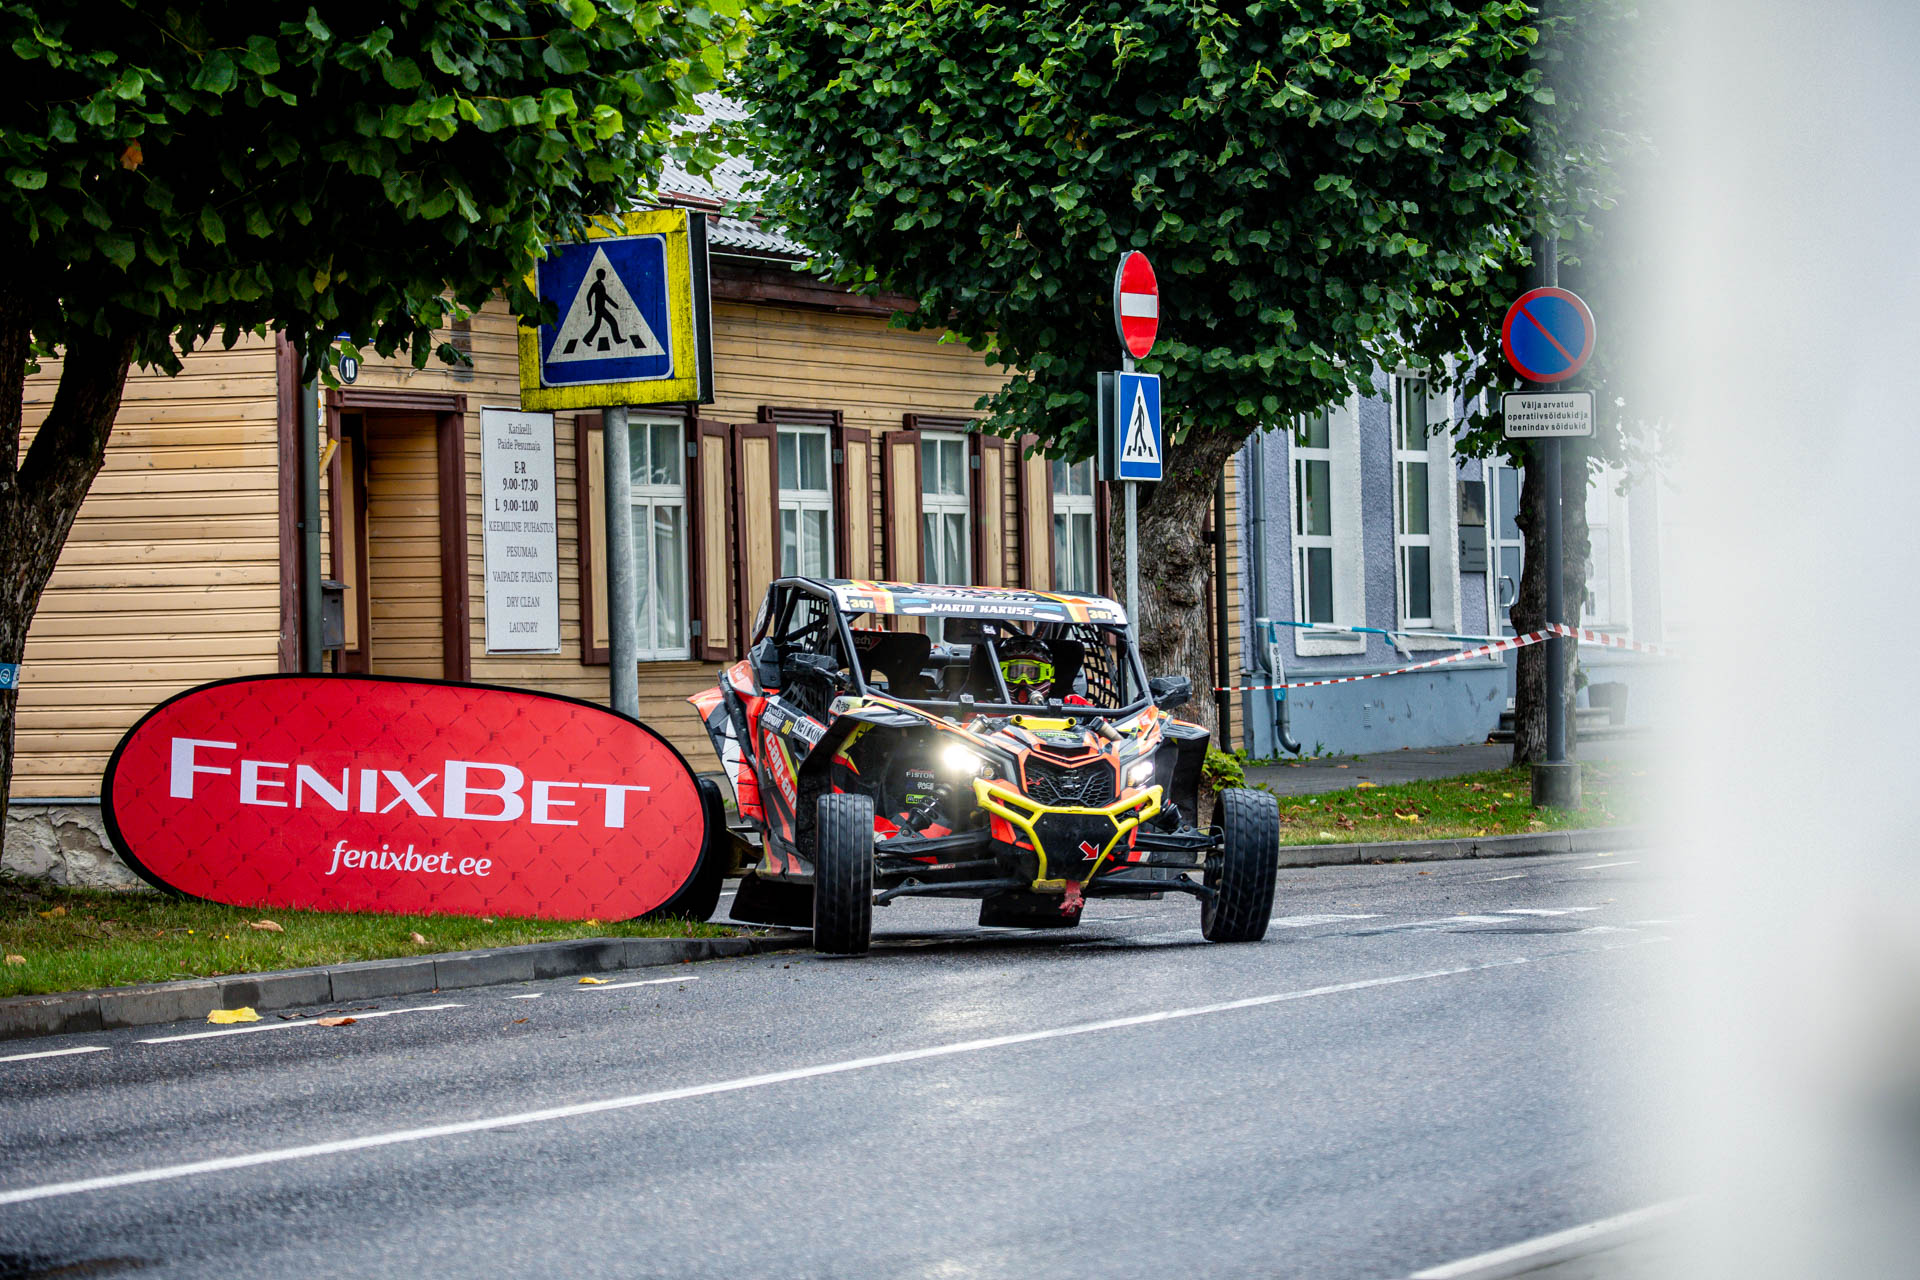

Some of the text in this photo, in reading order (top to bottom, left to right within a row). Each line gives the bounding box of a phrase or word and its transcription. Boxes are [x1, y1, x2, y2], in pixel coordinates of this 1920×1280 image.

[345, 359, 355, 378] 10
[1521, 400, 1574, 410] Välja arvatud
[1580, 411, 1589, 421] ja
[1509, 422, 1587, 432] teenindav sõidukid
[497, 438, 541, 453] Paide Pesumaja
[514, 461, 526, 474] E-R
[495, 498, 500, 511] L
[488, 520, 554, 533] KEEMILINE PUHASTUS
[506, 546, 538, 559] PESUMAJA
[492, 571, 553, 583] VAIPADE PUHASTUS
[506, 596, 540, 608] DRY CLEAN
[849, 599, 874, 609] 307
[930, 603, 1033, 616] MARIO KARUSE
[509, 622, 538, 633] LAUNDRY
[325, 839, 492, 877] fenixbet.ee
